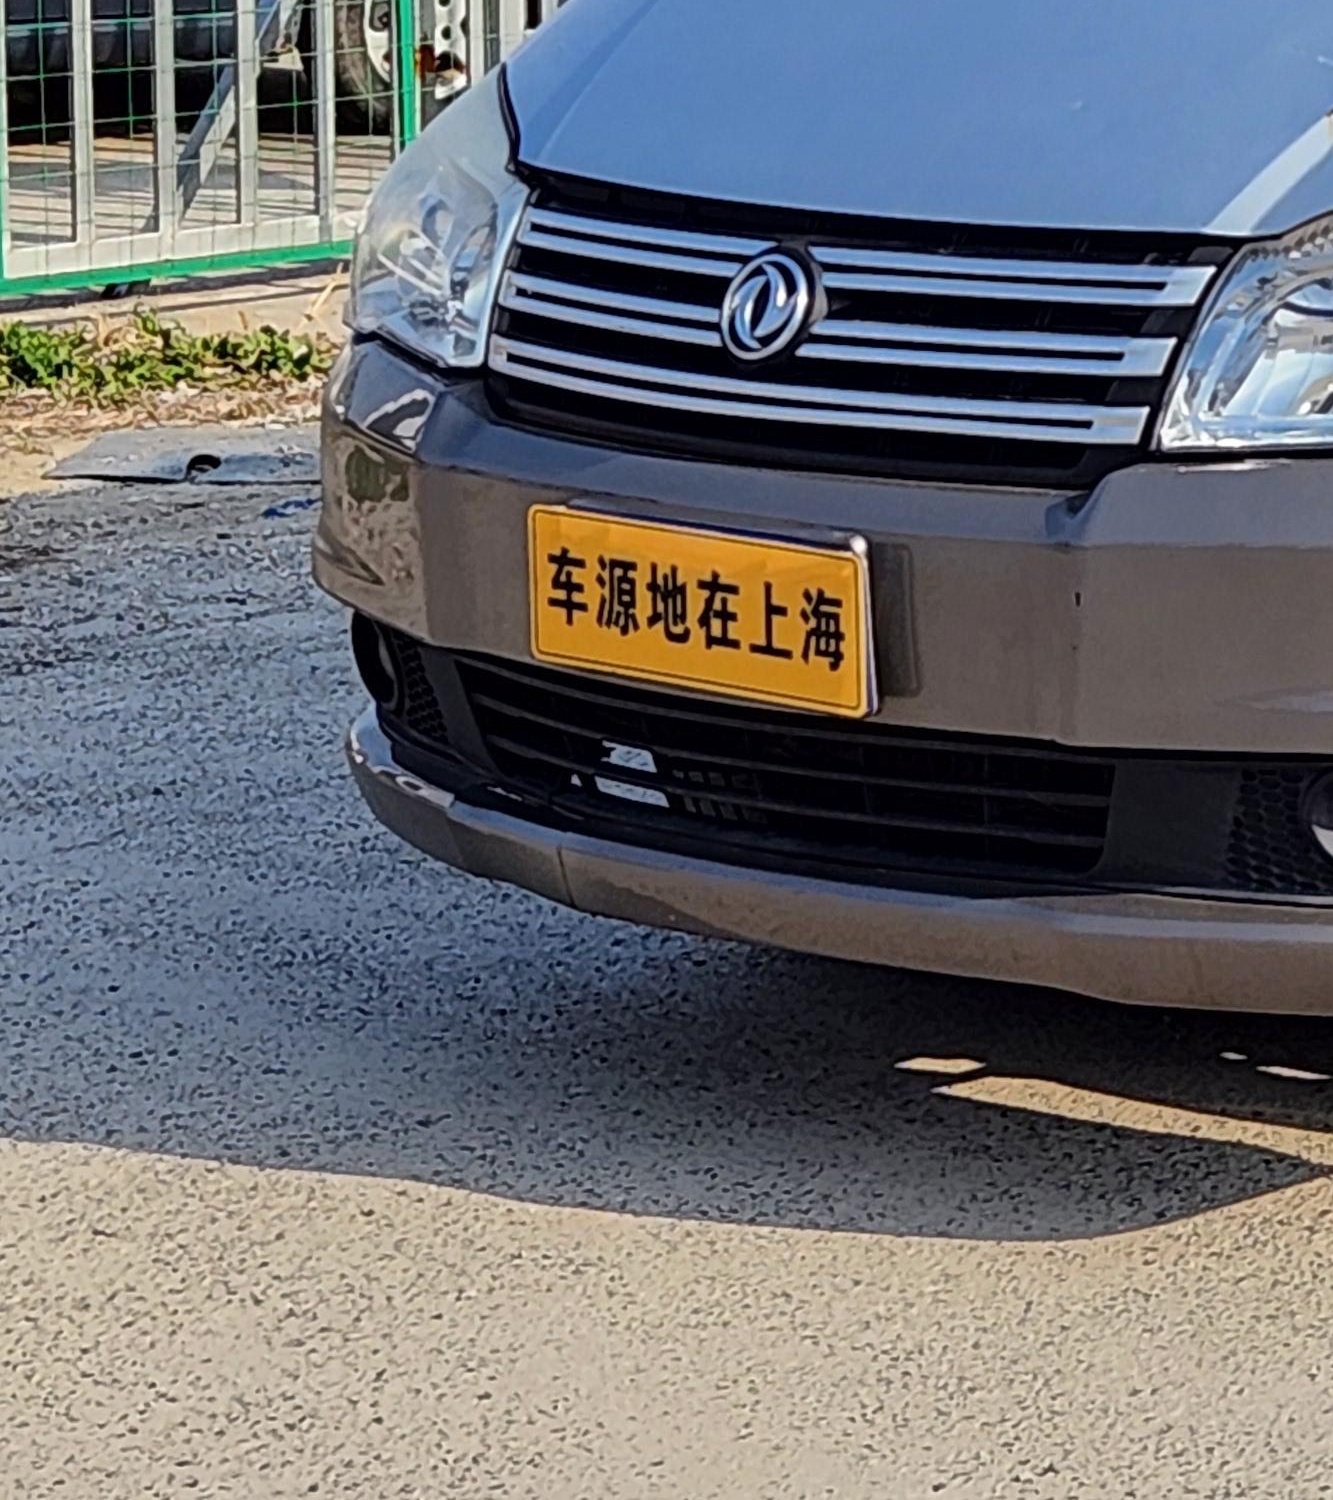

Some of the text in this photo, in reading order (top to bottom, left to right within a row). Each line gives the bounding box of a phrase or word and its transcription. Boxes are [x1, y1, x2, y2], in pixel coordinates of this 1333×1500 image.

[546, 545, 846, 672] 车源地在上海
